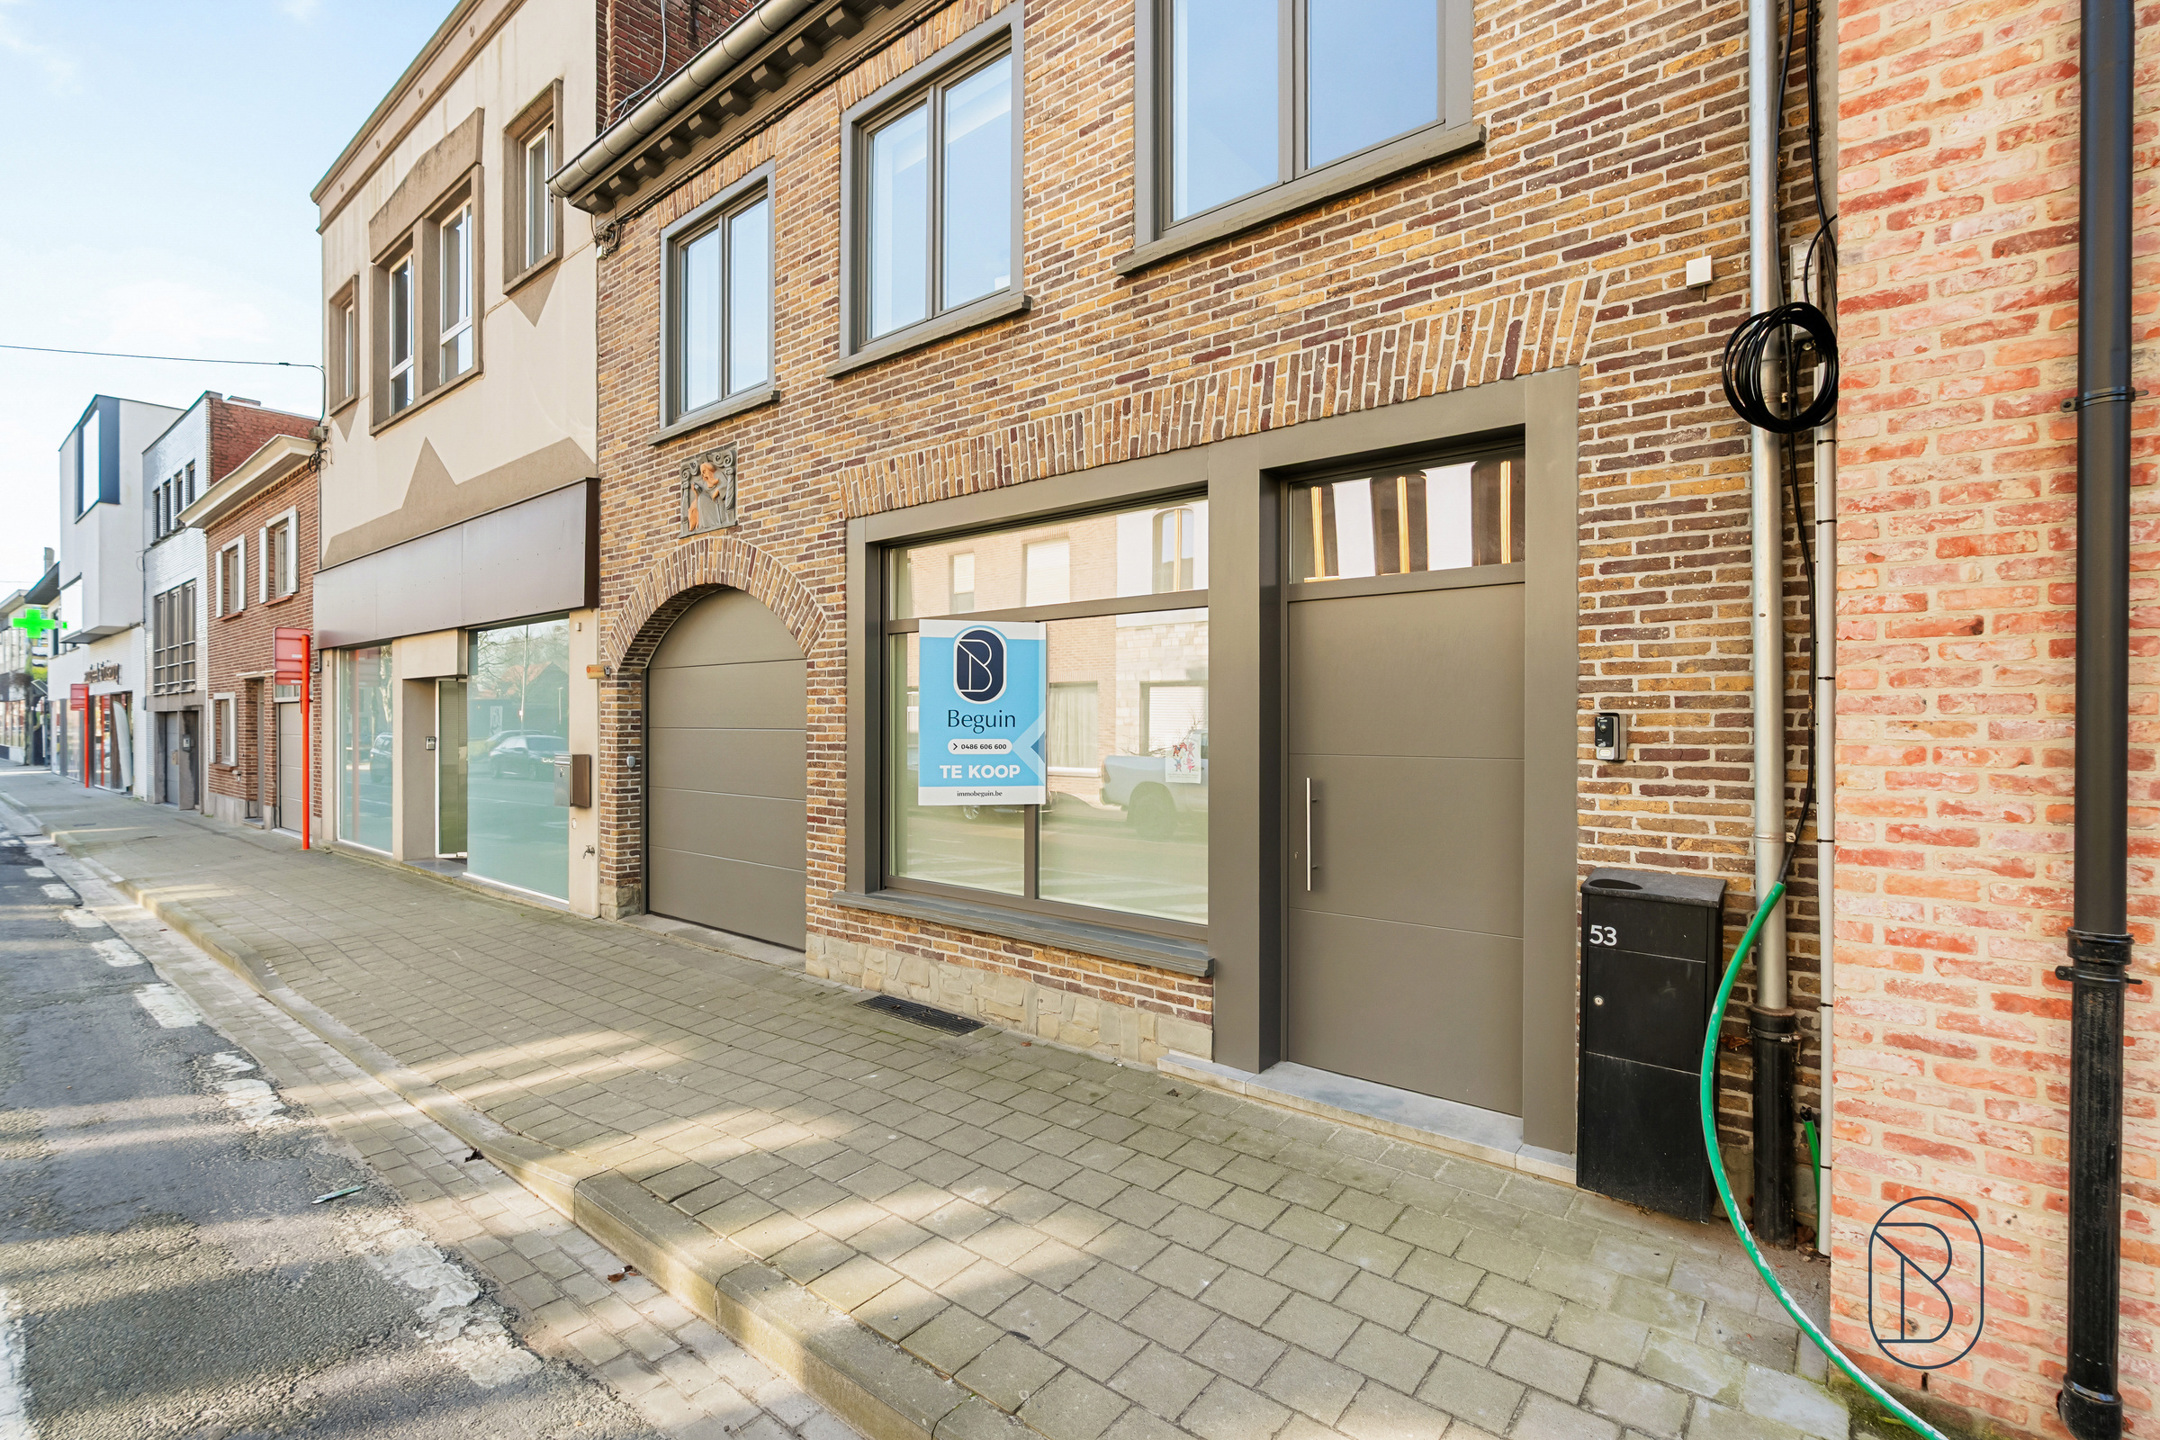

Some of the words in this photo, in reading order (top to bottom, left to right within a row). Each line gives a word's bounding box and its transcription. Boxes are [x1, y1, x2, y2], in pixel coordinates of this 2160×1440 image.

[947, 709, 1016, 734] Beguin
[939, 765, 963, 779] TE
[968, 765, 1021, 779] KOOP
[956, 789, 1003, 798] immobeguin.be
[1589, 924, 1617, 946] 53
